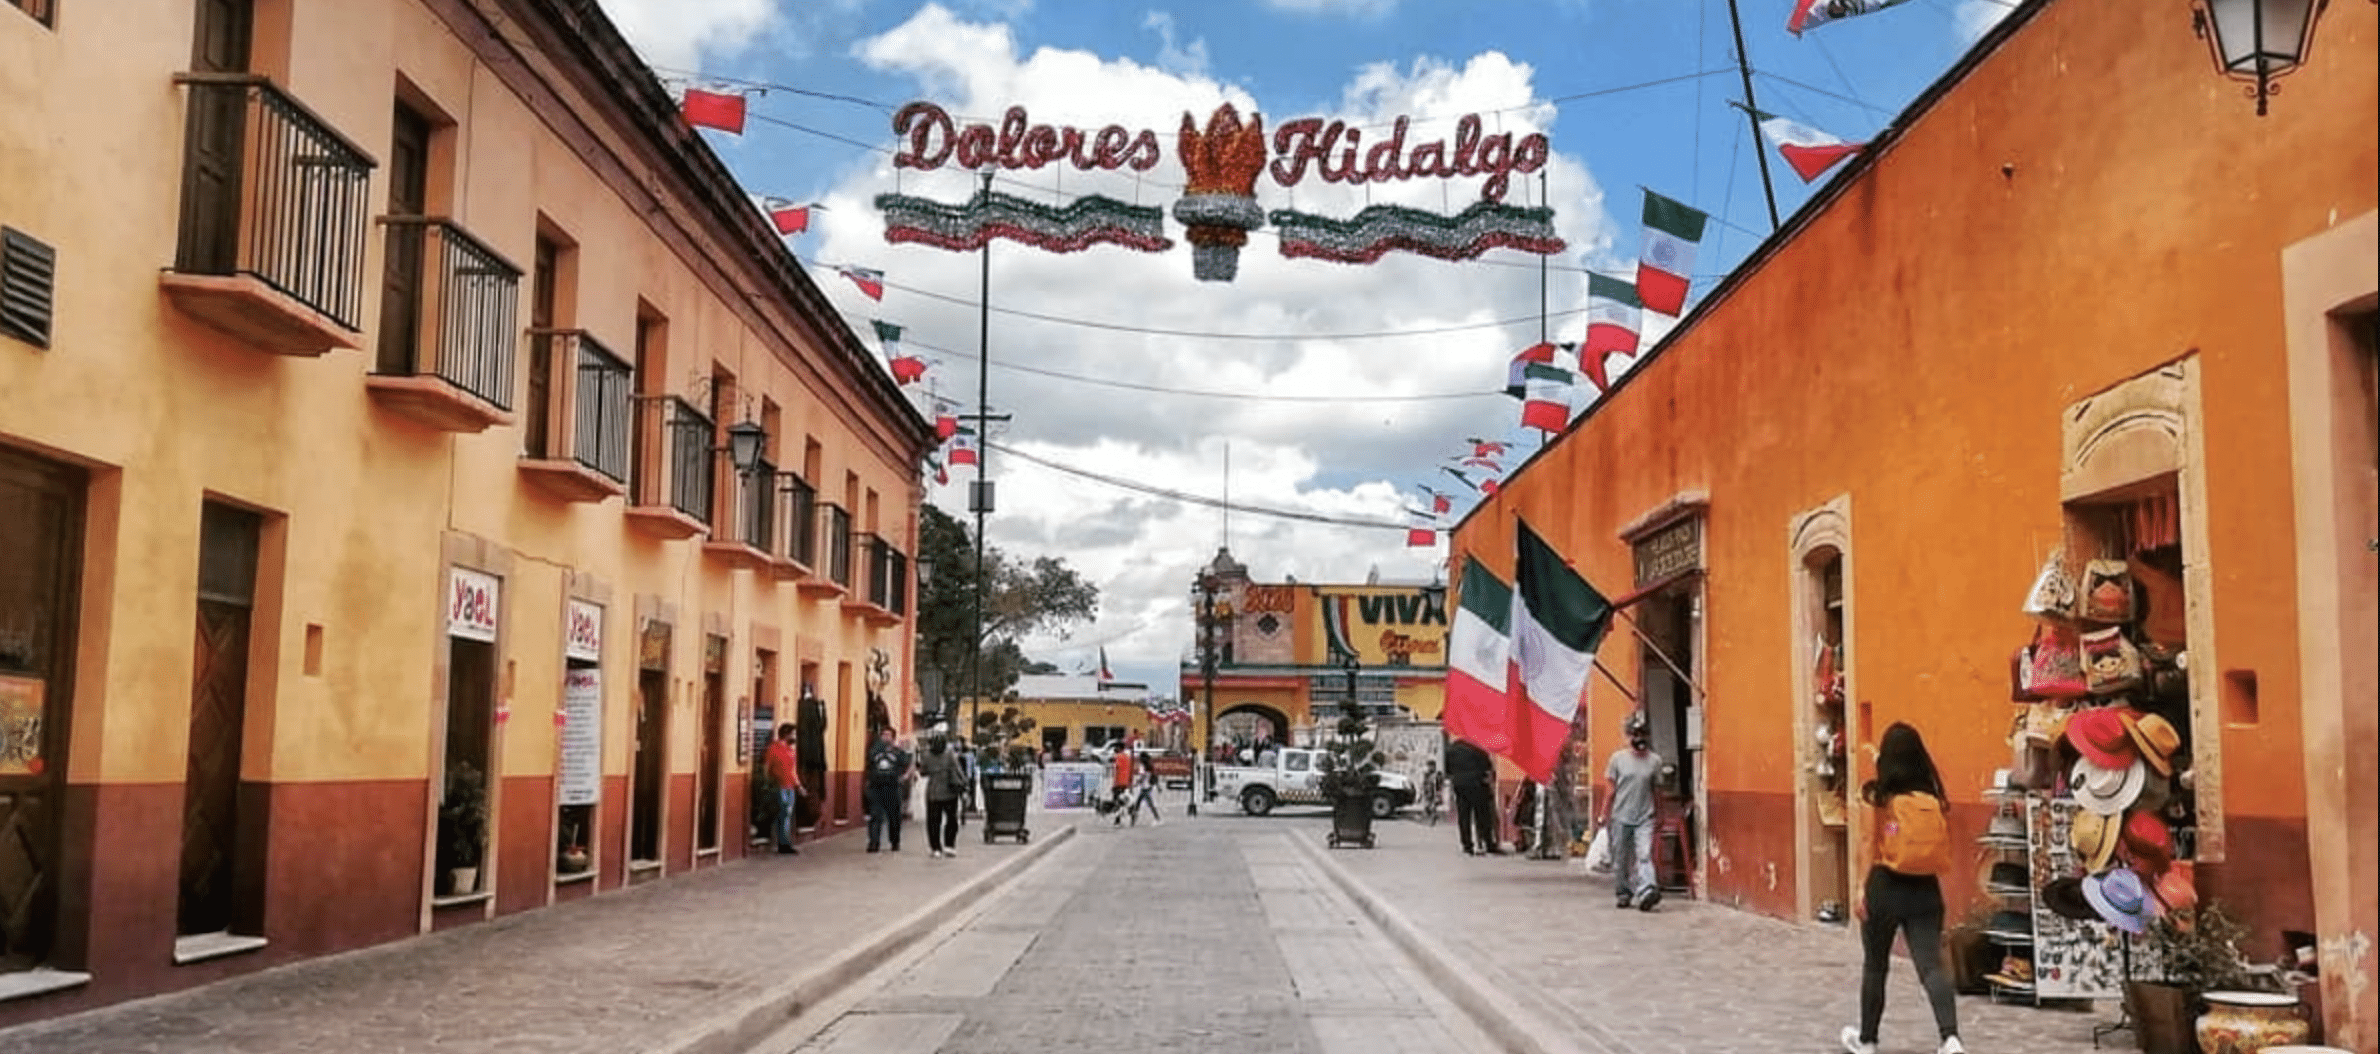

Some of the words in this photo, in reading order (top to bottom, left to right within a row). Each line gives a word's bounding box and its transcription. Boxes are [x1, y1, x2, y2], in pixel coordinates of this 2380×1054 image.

[893, 102, 1161, 171] Dolores
[1268, 112, 1550, 201] Hidalgo
[1358, 594, 1447, 626] VIVA
